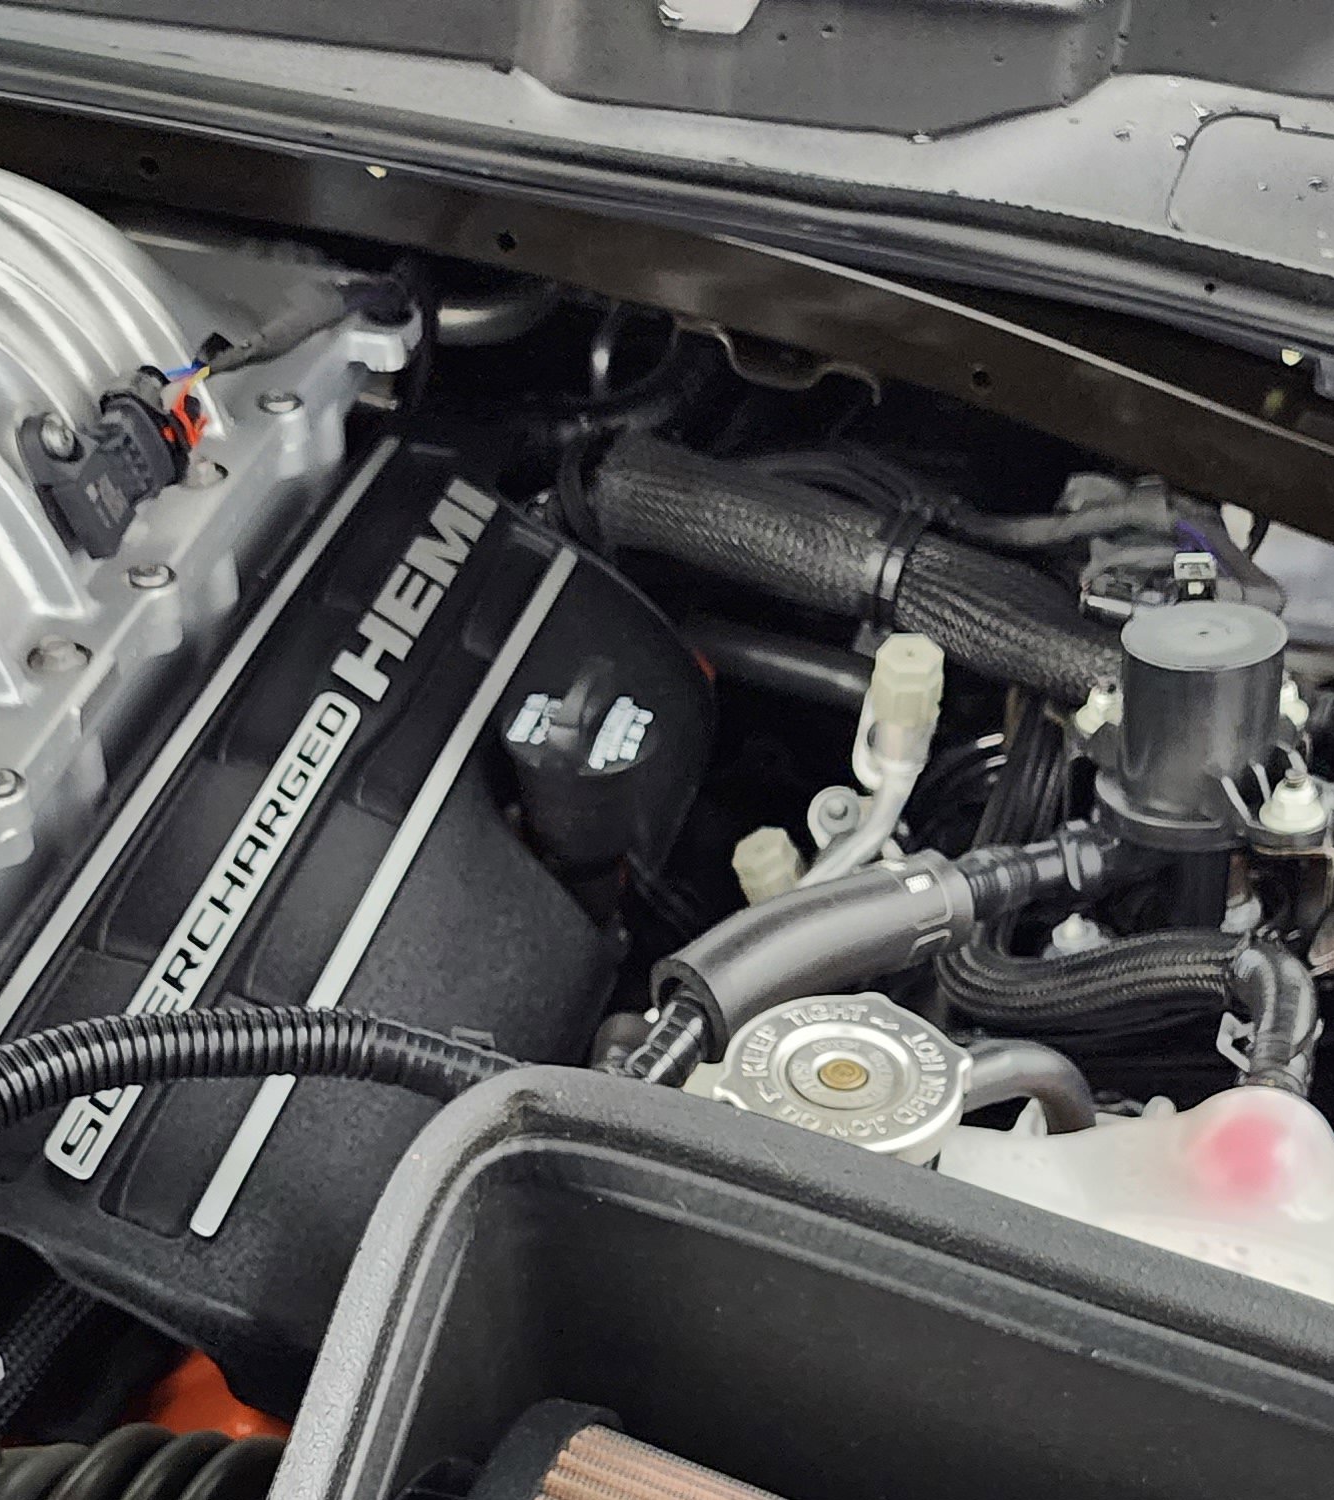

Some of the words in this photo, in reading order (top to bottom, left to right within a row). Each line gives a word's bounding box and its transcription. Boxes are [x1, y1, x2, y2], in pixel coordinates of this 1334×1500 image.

[61, 701, 353, 1167] SUERCHARGED
[331, 478, 498, 702] HEMI
[741, 1024, 778, 1077] KEEP
[782, 1003, 868, 1027] TIGHT
[828, 1114, 889, 1137] NOT
[901, 1032, 948, 1072] HOT
